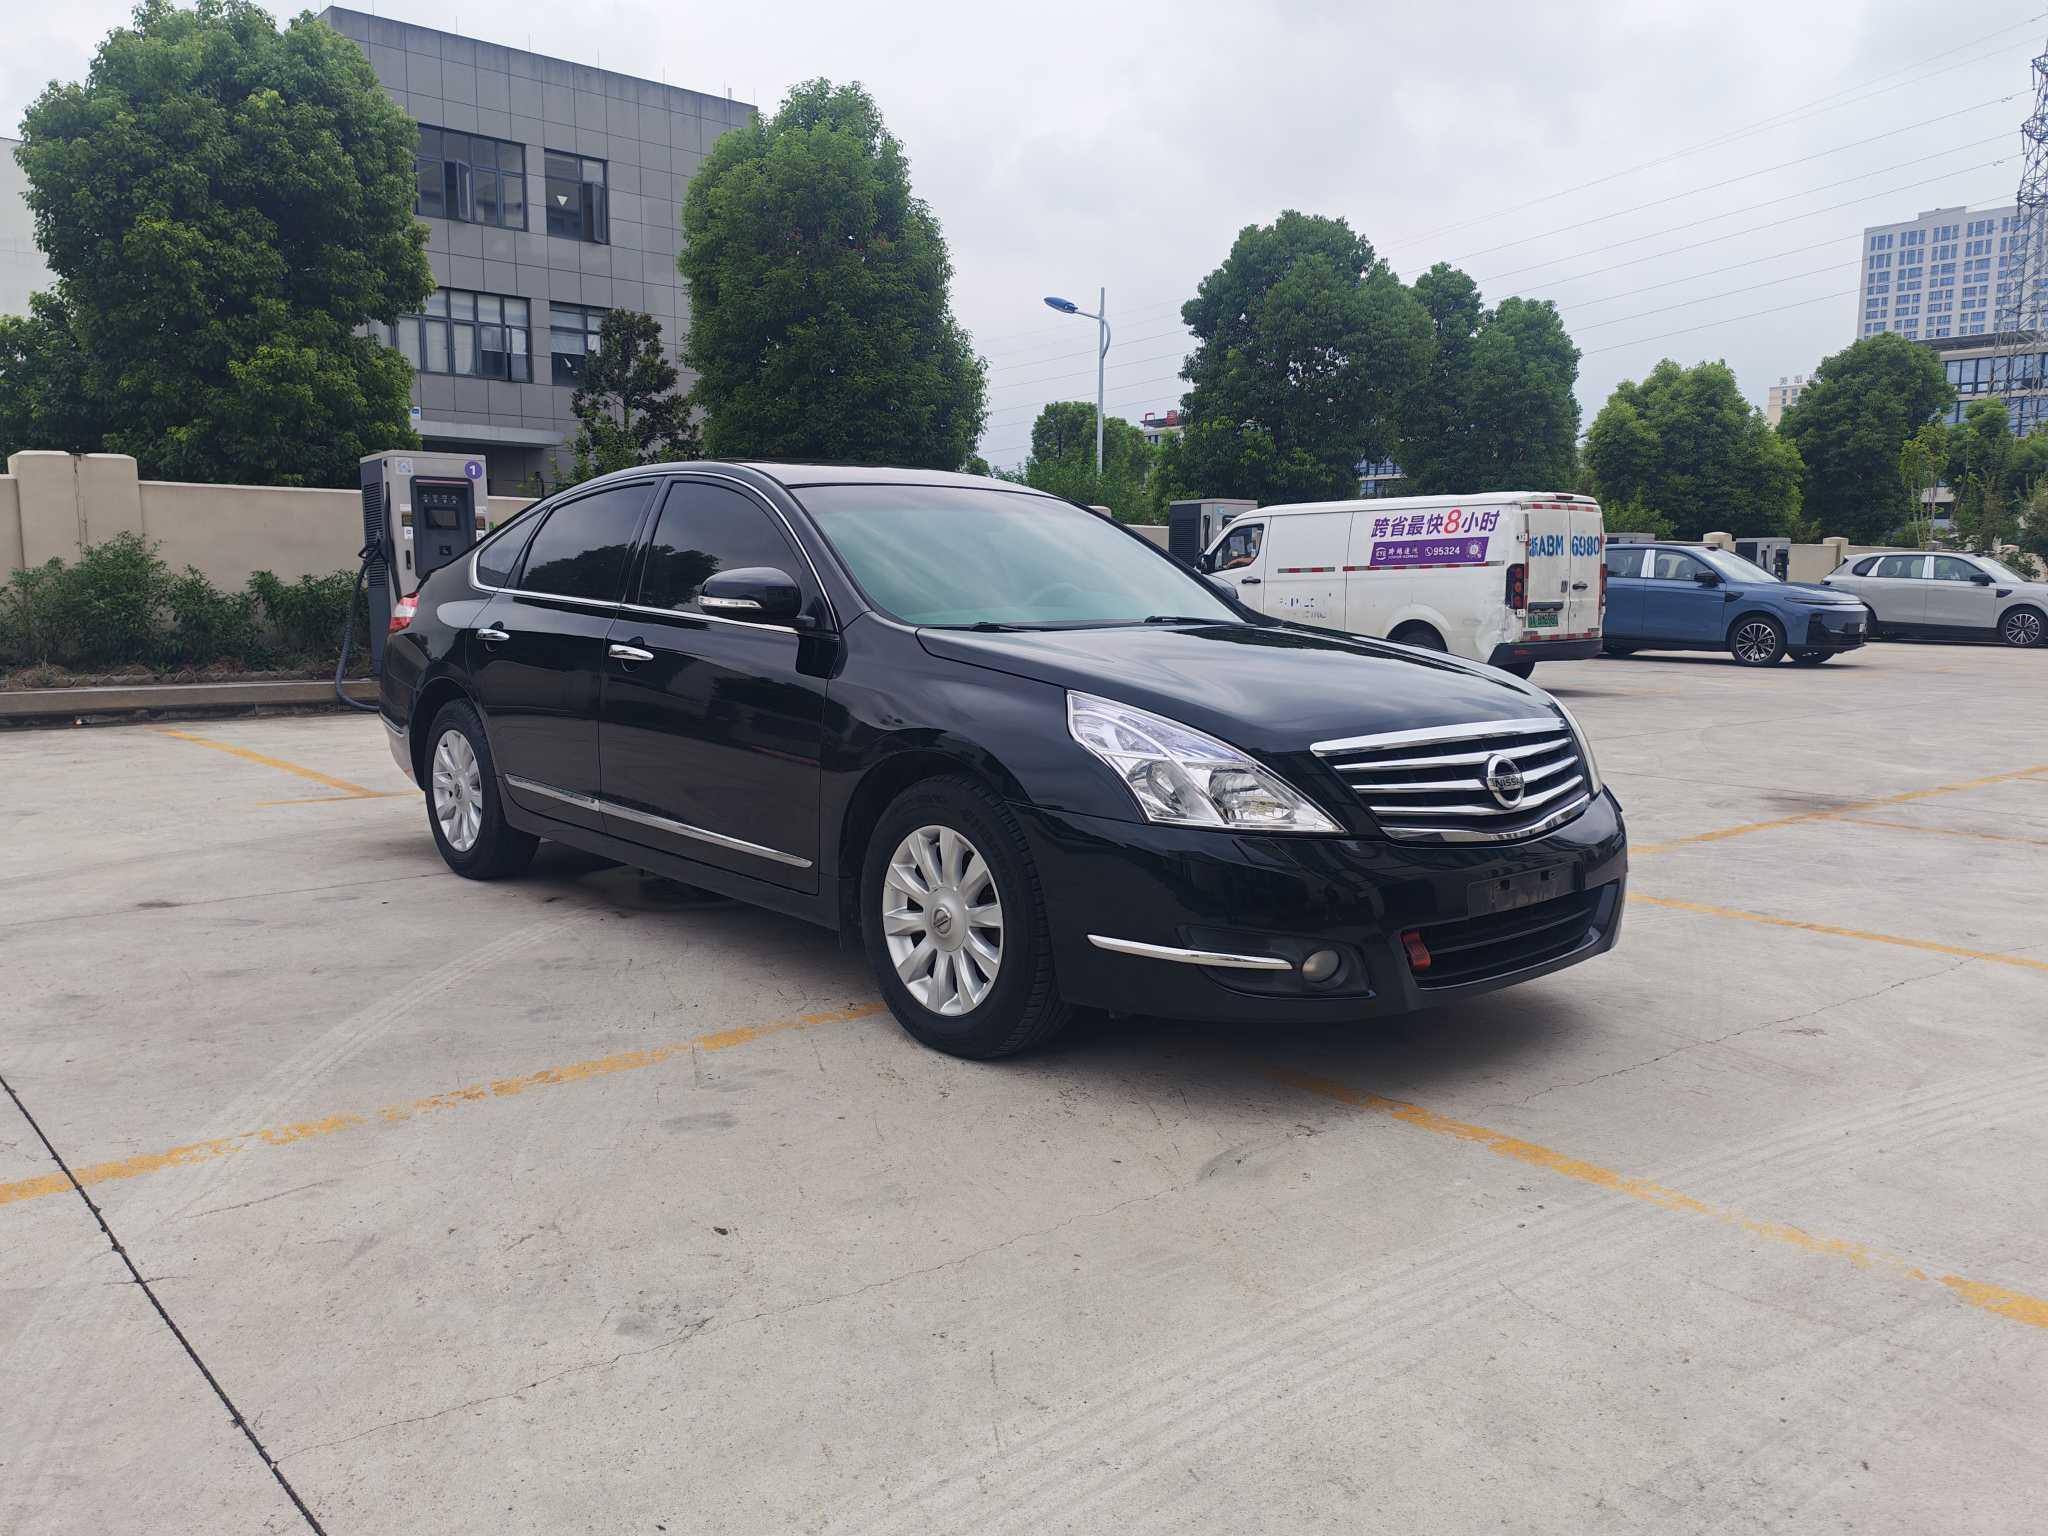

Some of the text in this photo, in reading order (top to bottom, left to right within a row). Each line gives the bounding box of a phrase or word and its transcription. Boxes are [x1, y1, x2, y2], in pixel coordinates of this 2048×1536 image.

[469, 465, 476, 476] 1
[1371, 509, 1500, 538] 跨省最快8小时
[1433, 547, 1460, 556] 95324
[1572, 535, 1600, 557] 6980
[1493, 775, 1522, 788] NISSA
